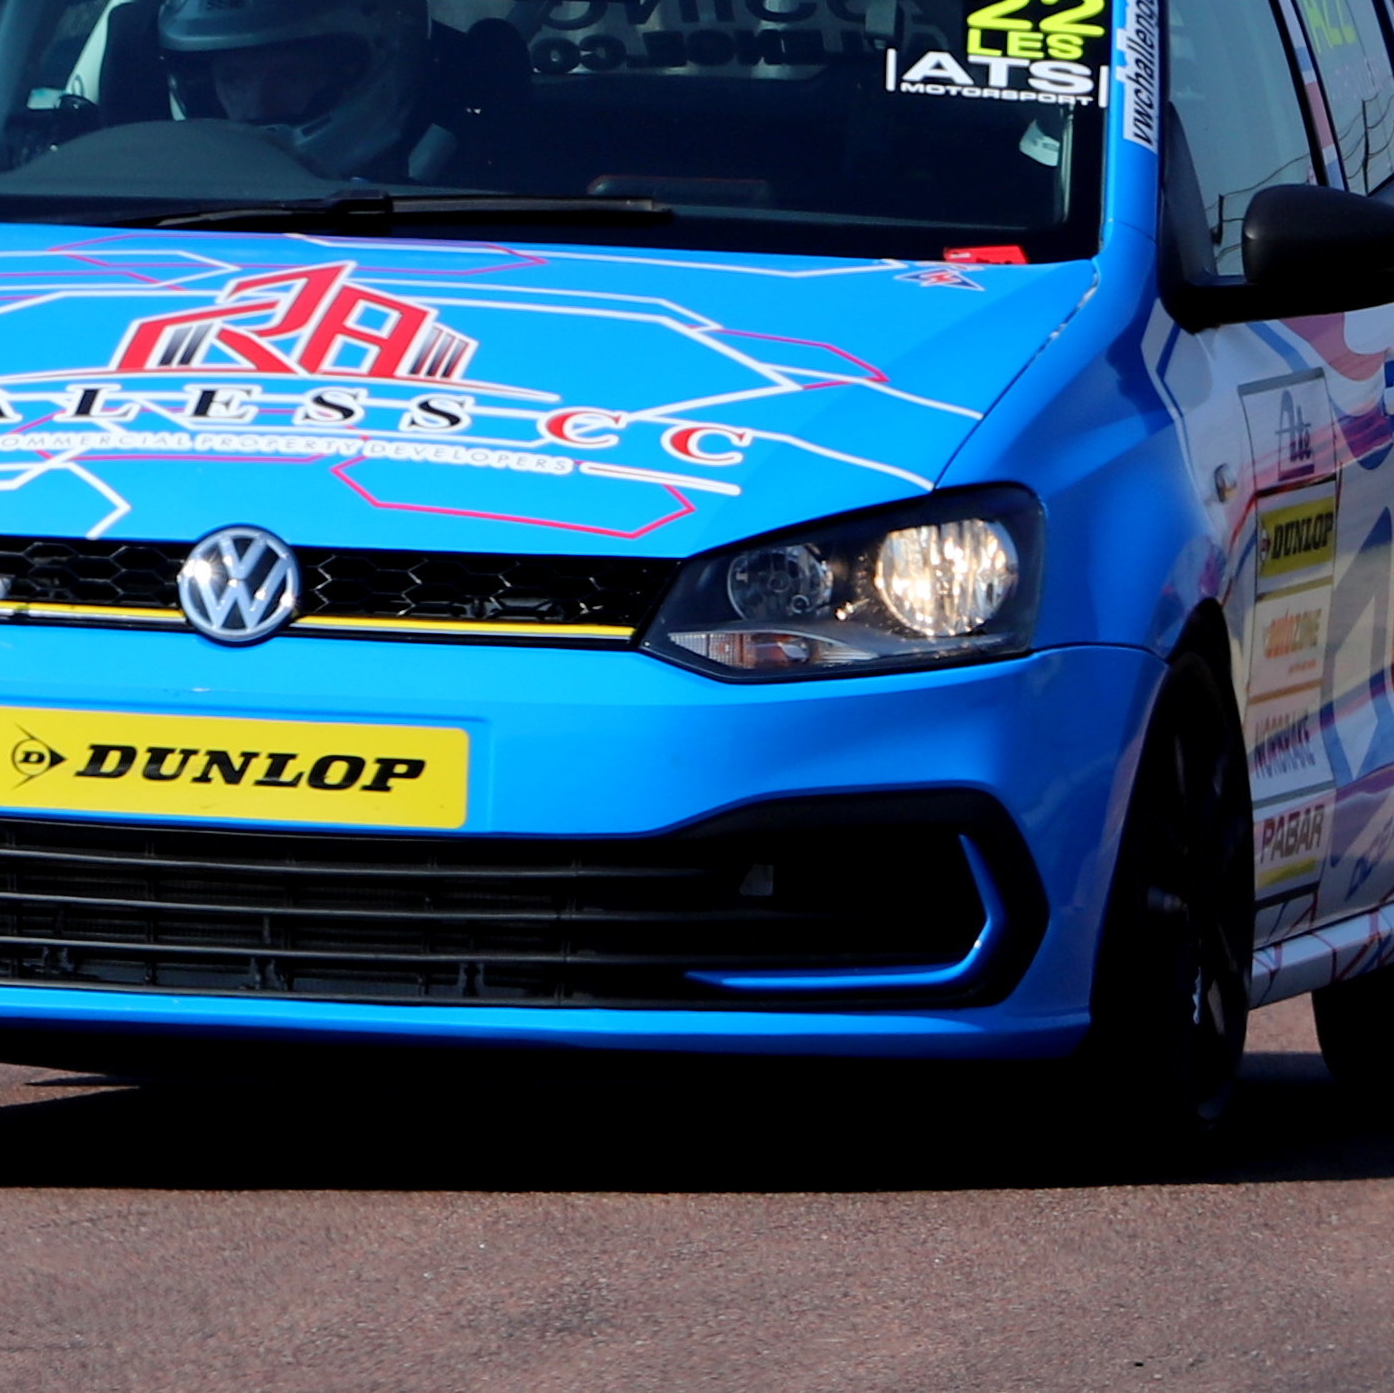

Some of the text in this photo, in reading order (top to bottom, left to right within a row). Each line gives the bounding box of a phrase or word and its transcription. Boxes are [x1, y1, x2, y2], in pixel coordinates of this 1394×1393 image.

[967, 28, 1084, 60] LES
[900, 81, 1094, 106] MOTORSPORT
[901, 51, 1095, 95] ATS
[201, 437, 356, 453] PROPERTY
[370, 443, 568, 471] DEVELOPERS
[1270, 511, 1334, 560] DUNLOP
[74, 743, 426, 793] DUNLOP
[1260, 804, 1325, 863] PABAR
